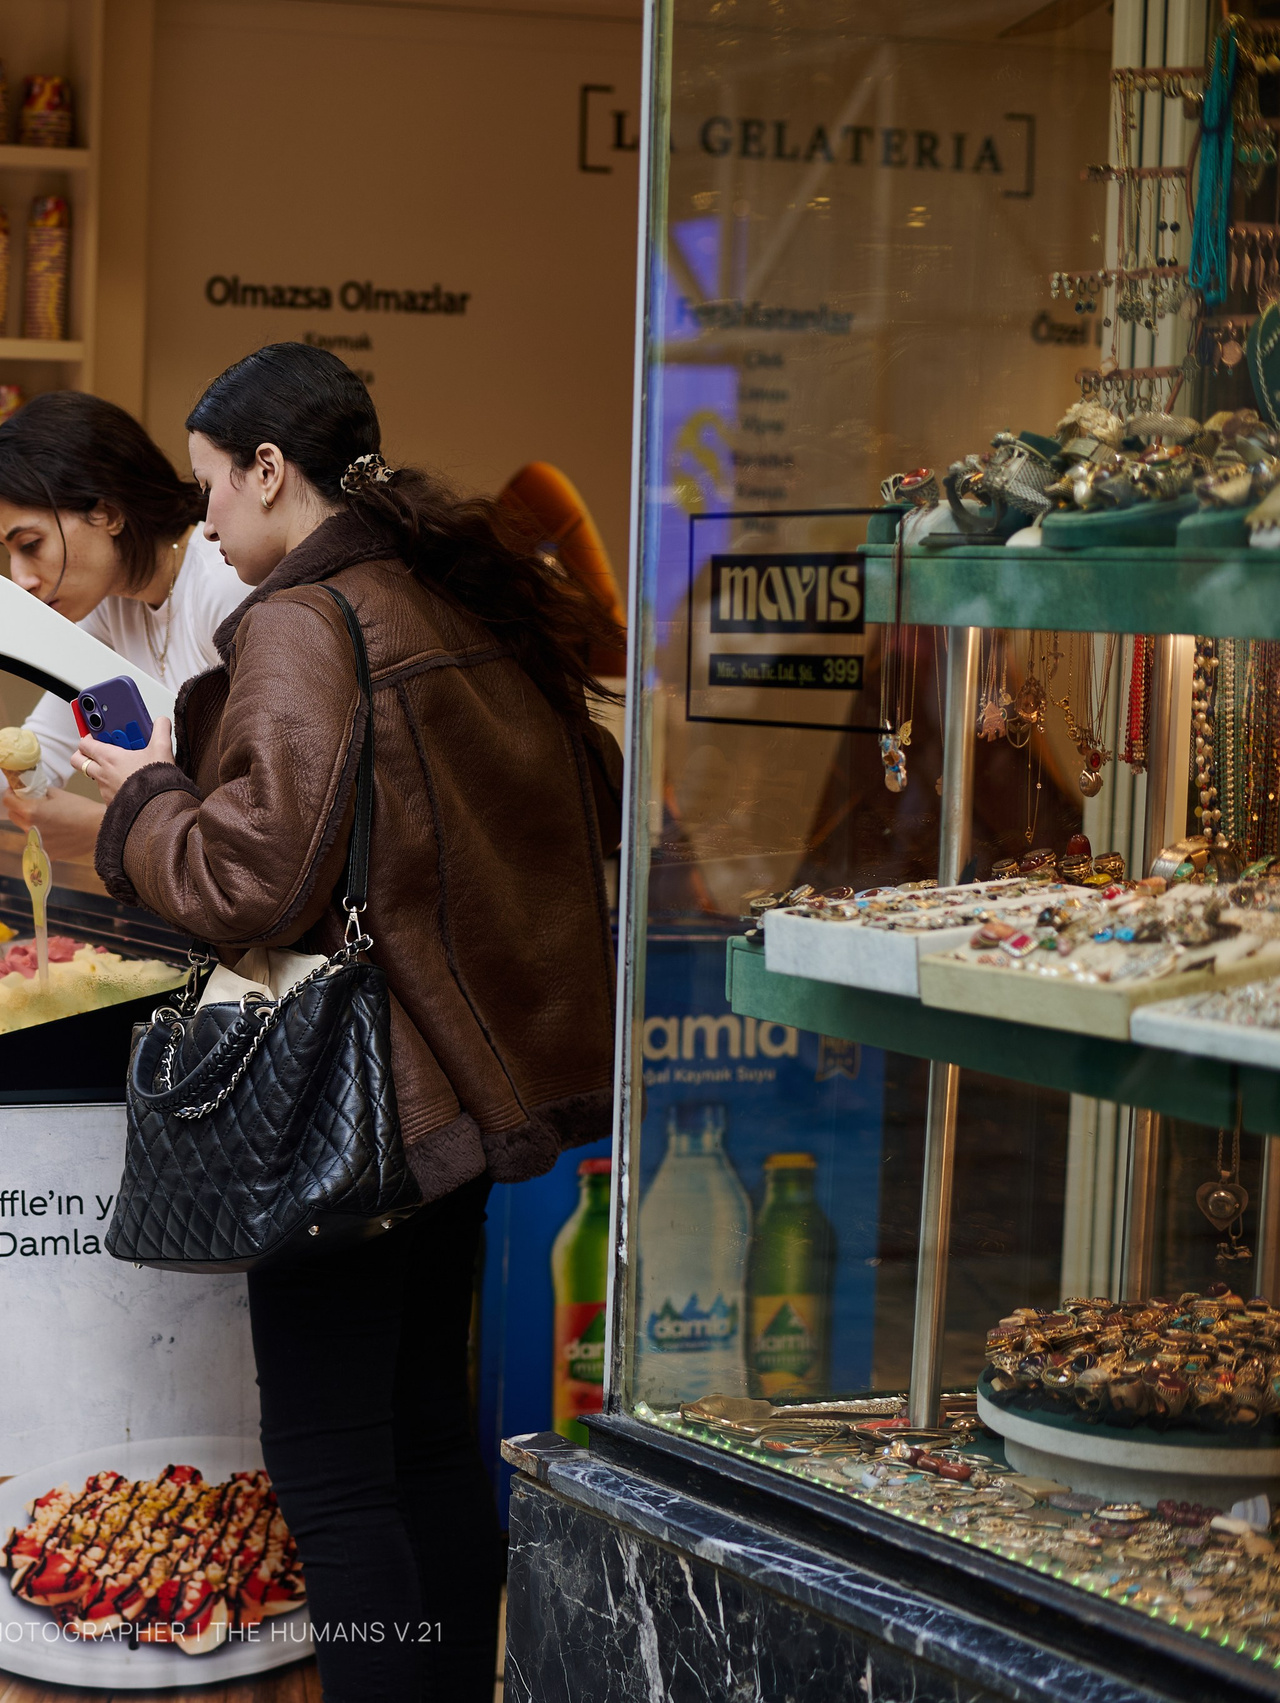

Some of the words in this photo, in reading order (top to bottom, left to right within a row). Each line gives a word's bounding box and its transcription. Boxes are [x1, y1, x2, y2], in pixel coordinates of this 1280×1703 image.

[699, 115, 1005, 174] GELATERIA
[205, 275, 332, 311] Olmazsa
[339, 280, 471, 315] Olmazlar
[822, 658, 860, 684] 399
[643, 1014, 799, 1061] amla
